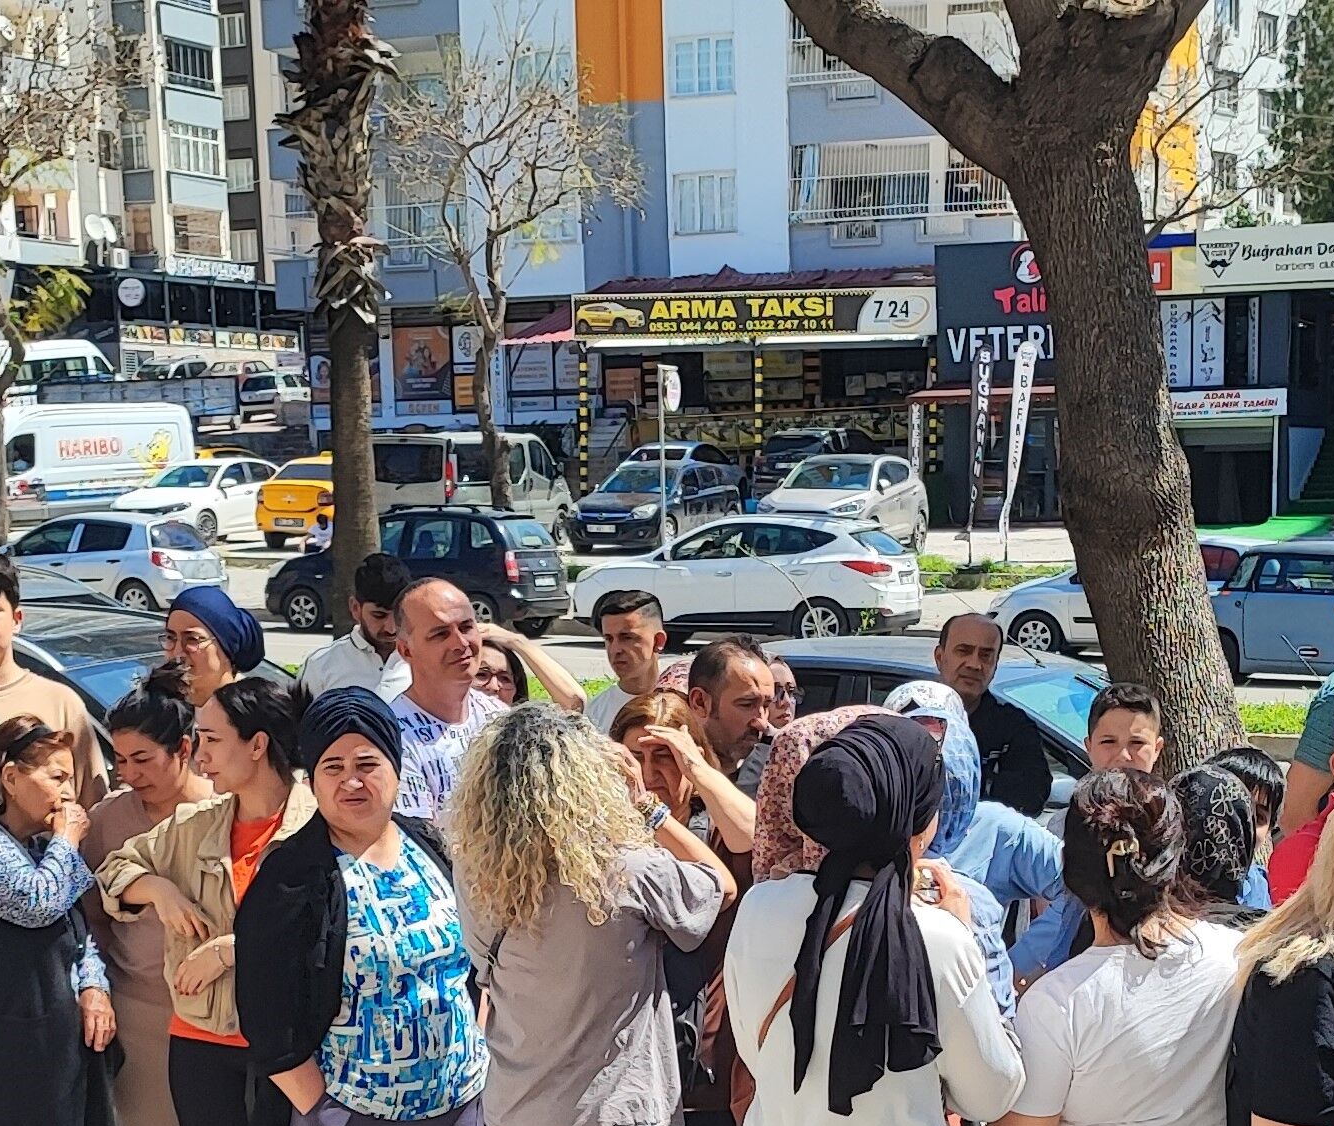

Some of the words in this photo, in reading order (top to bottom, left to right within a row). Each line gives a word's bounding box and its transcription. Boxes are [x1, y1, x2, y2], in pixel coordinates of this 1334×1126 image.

[1241, 244, 1313, 262] Buğrahan
[648, 299, 738, 320] ARMA
[993, 286, 1047, 314] Tali
[648, 320, 676, 333] 0553
[679, 320, 702, 332] 044
[703, 320, 719, 332] 44
[721, 320, 737, 332] 00
[745, 319, 776, 331] 0322
[776, 319, 800, 331] 247
[801, 318, 818, 330] 10
[819, 318, 835, 330] 11
[1203, 391, 1241, 400] ADANA
[58, 437, 122, 459] HARIBO
